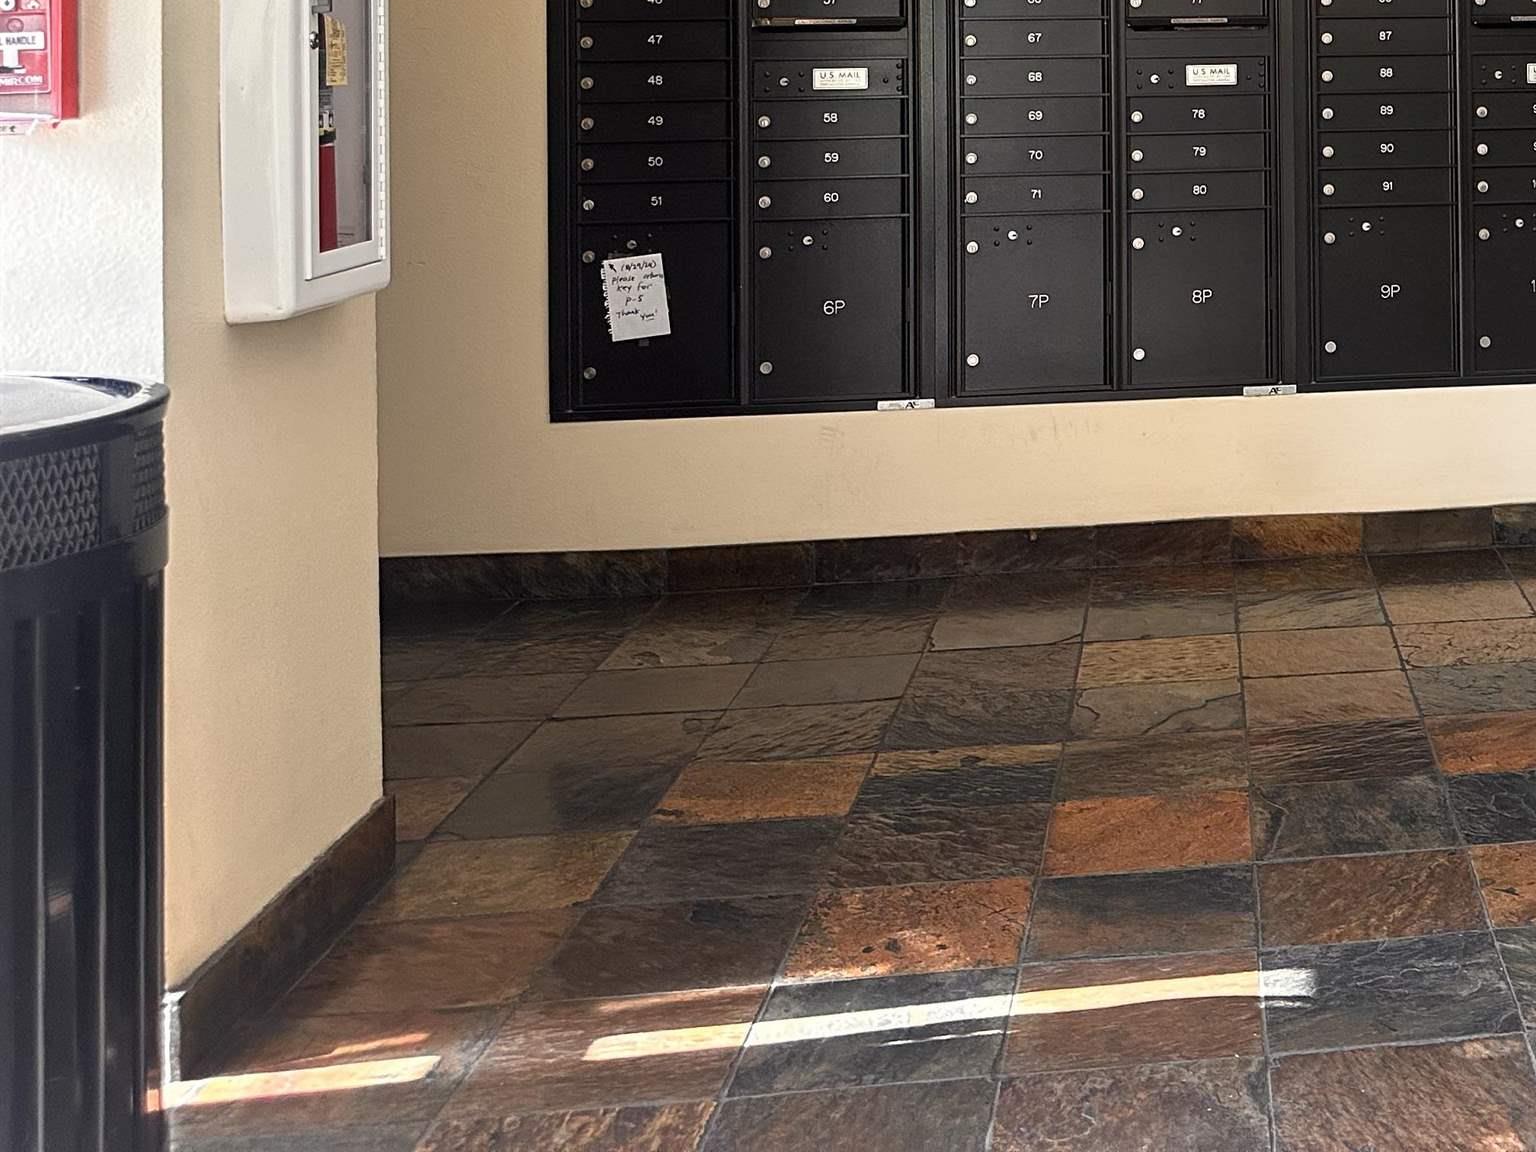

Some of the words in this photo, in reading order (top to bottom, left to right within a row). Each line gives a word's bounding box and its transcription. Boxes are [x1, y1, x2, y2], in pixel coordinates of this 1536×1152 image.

[5, 35, 37, 45] HANDLE
[647, 34, 663, 45] 47
[1027, 32, 1042, 43] 67
[1379, 30, 1393, 41] 87
[839, 71, 861, 79] MAIL
[1209, 66, 1231, 75] MAIL
[1379, 67, 1393, 78] 88
[647, 75, 663, 86] 48
[1028, 71, 1043, 82] 68
[1028, 110, 1043, 121] 69
[1191, 108, 1206, 119] 78
[1380, 105, 1394, 116] 89
[647, 115, 664, 126] 49
[823, 112, 838, 123] 58
[1192, 146, 1207, 157] 79
[1380, 143, 1395, 154] 90
[824, 152, 839, 163] 59
[1028, 150, 1043, 160] 70
[647, 156, 664, 167] 50
[1192, 184, 1207, 195] 80
[1382, 181, 1393, 191] 91
[823, 192, 839, 203] 60
[1031, 189, 1042, 199] 71
[650, 196, 662, 207] 51
[1191, 289, 1213, 304] 8P
[1380, 284, 1401, 299] 9P
[823, 299, 846, 315] 6P
[1028, 294, 1049, 309] 7P
